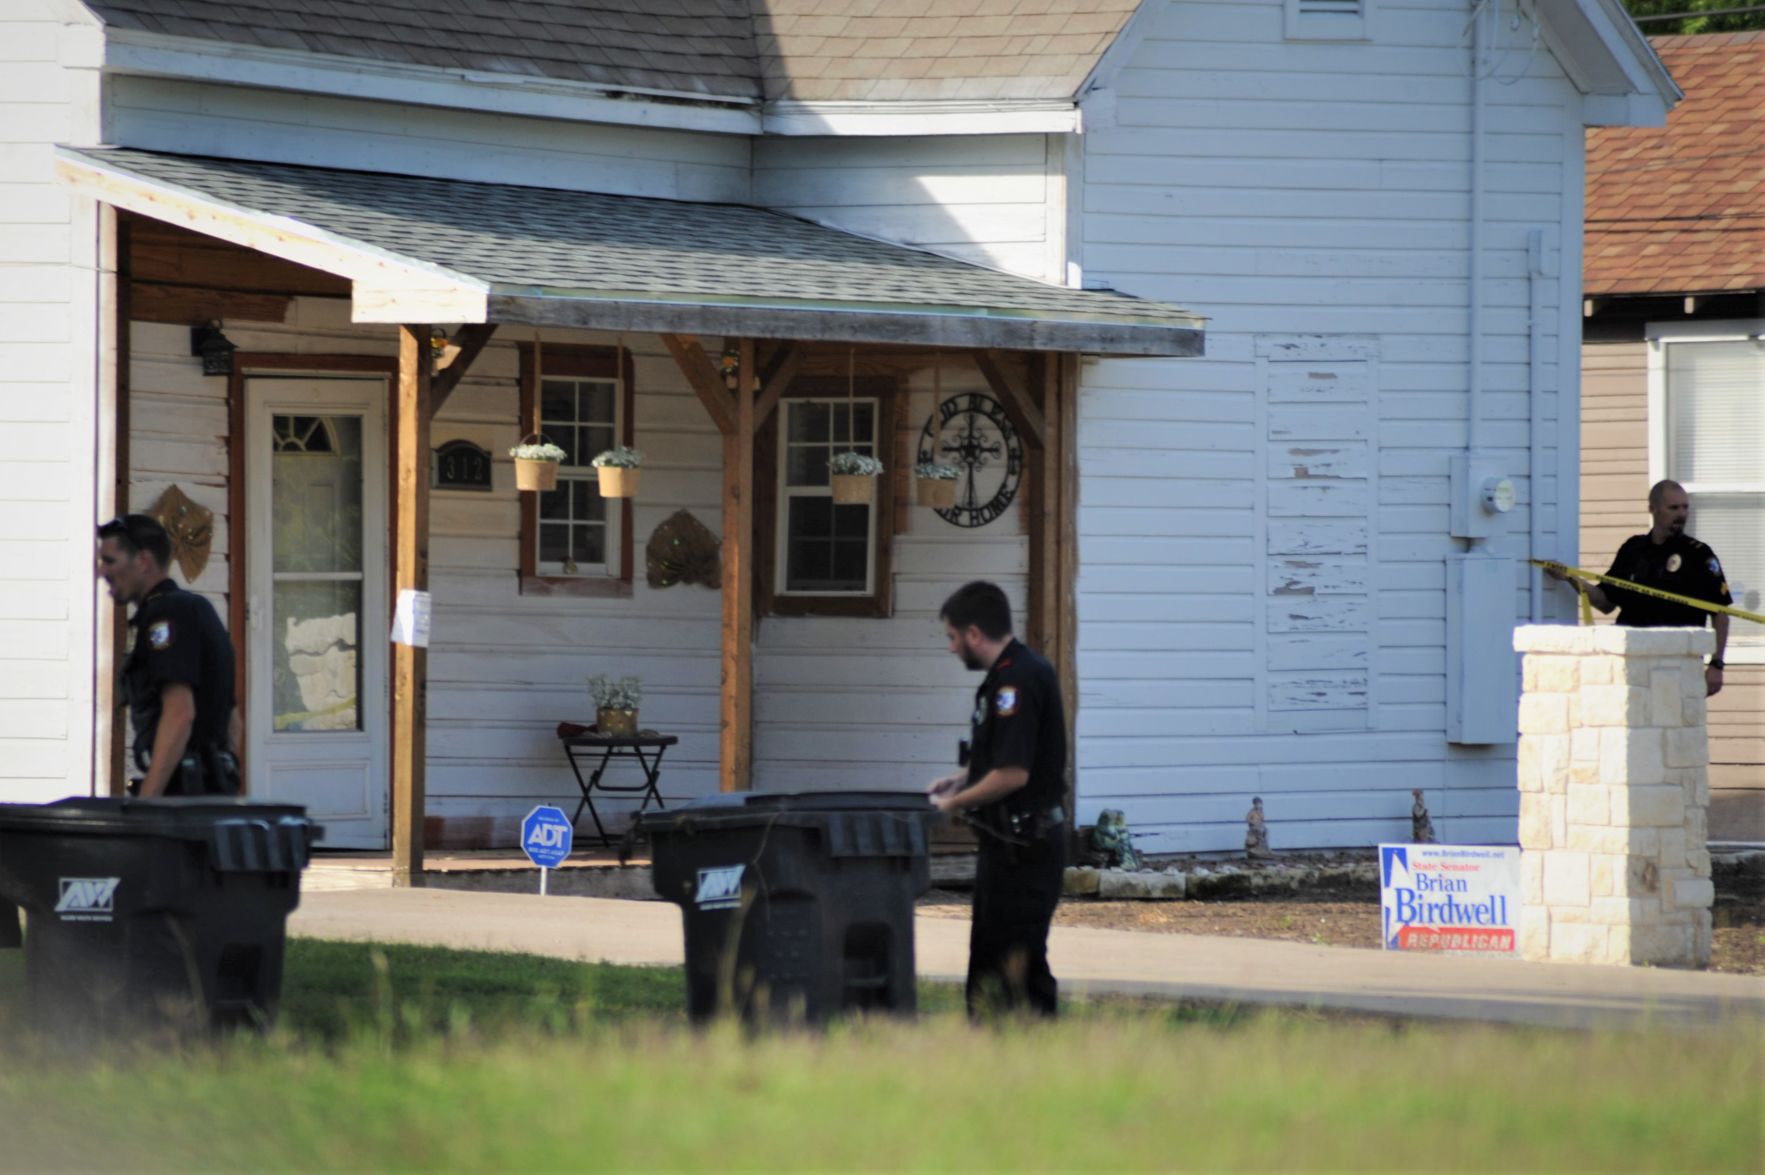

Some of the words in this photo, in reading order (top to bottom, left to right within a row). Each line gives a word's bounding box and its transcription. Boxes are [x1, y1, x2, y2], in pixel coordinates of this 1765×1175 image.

[446, 455, 483, 480] 312
[969, 482, 1016, 528] HOME
[527, 822, 569, 849] ADT
[1412, 862, 1438, 872] State
[1441, 862, 1481, 872] Senator
[1415, 872, 1468, 893] Brian
[1395, 887, 1508, 926] Birdwell
[1407, 932, 1512, 951] REPUBLICAN
